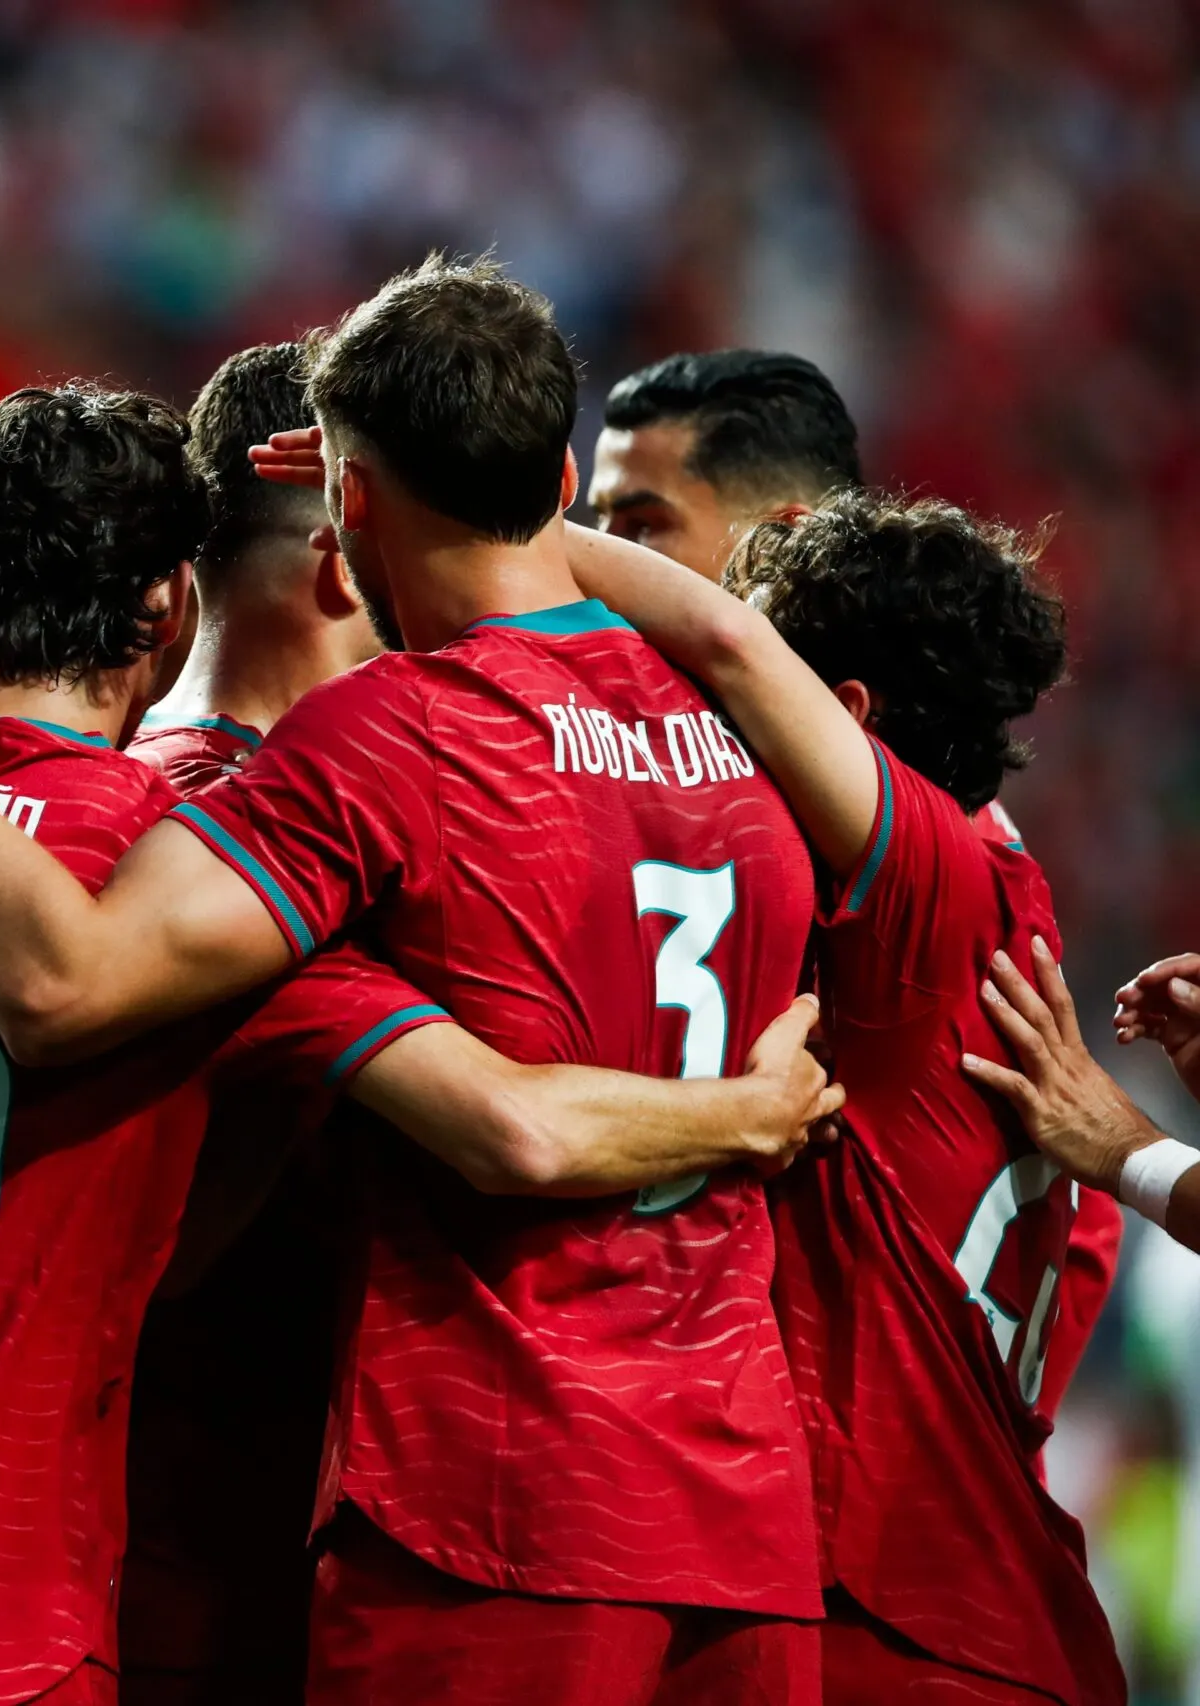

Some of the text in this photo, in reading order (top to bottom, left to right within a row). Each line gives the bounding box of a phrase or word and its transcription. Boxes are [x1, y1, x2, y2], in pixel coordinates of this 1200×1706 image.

[541, 692, 755, 788] RÚBEN DIAS
[632, 859, 736, 1216] 3
